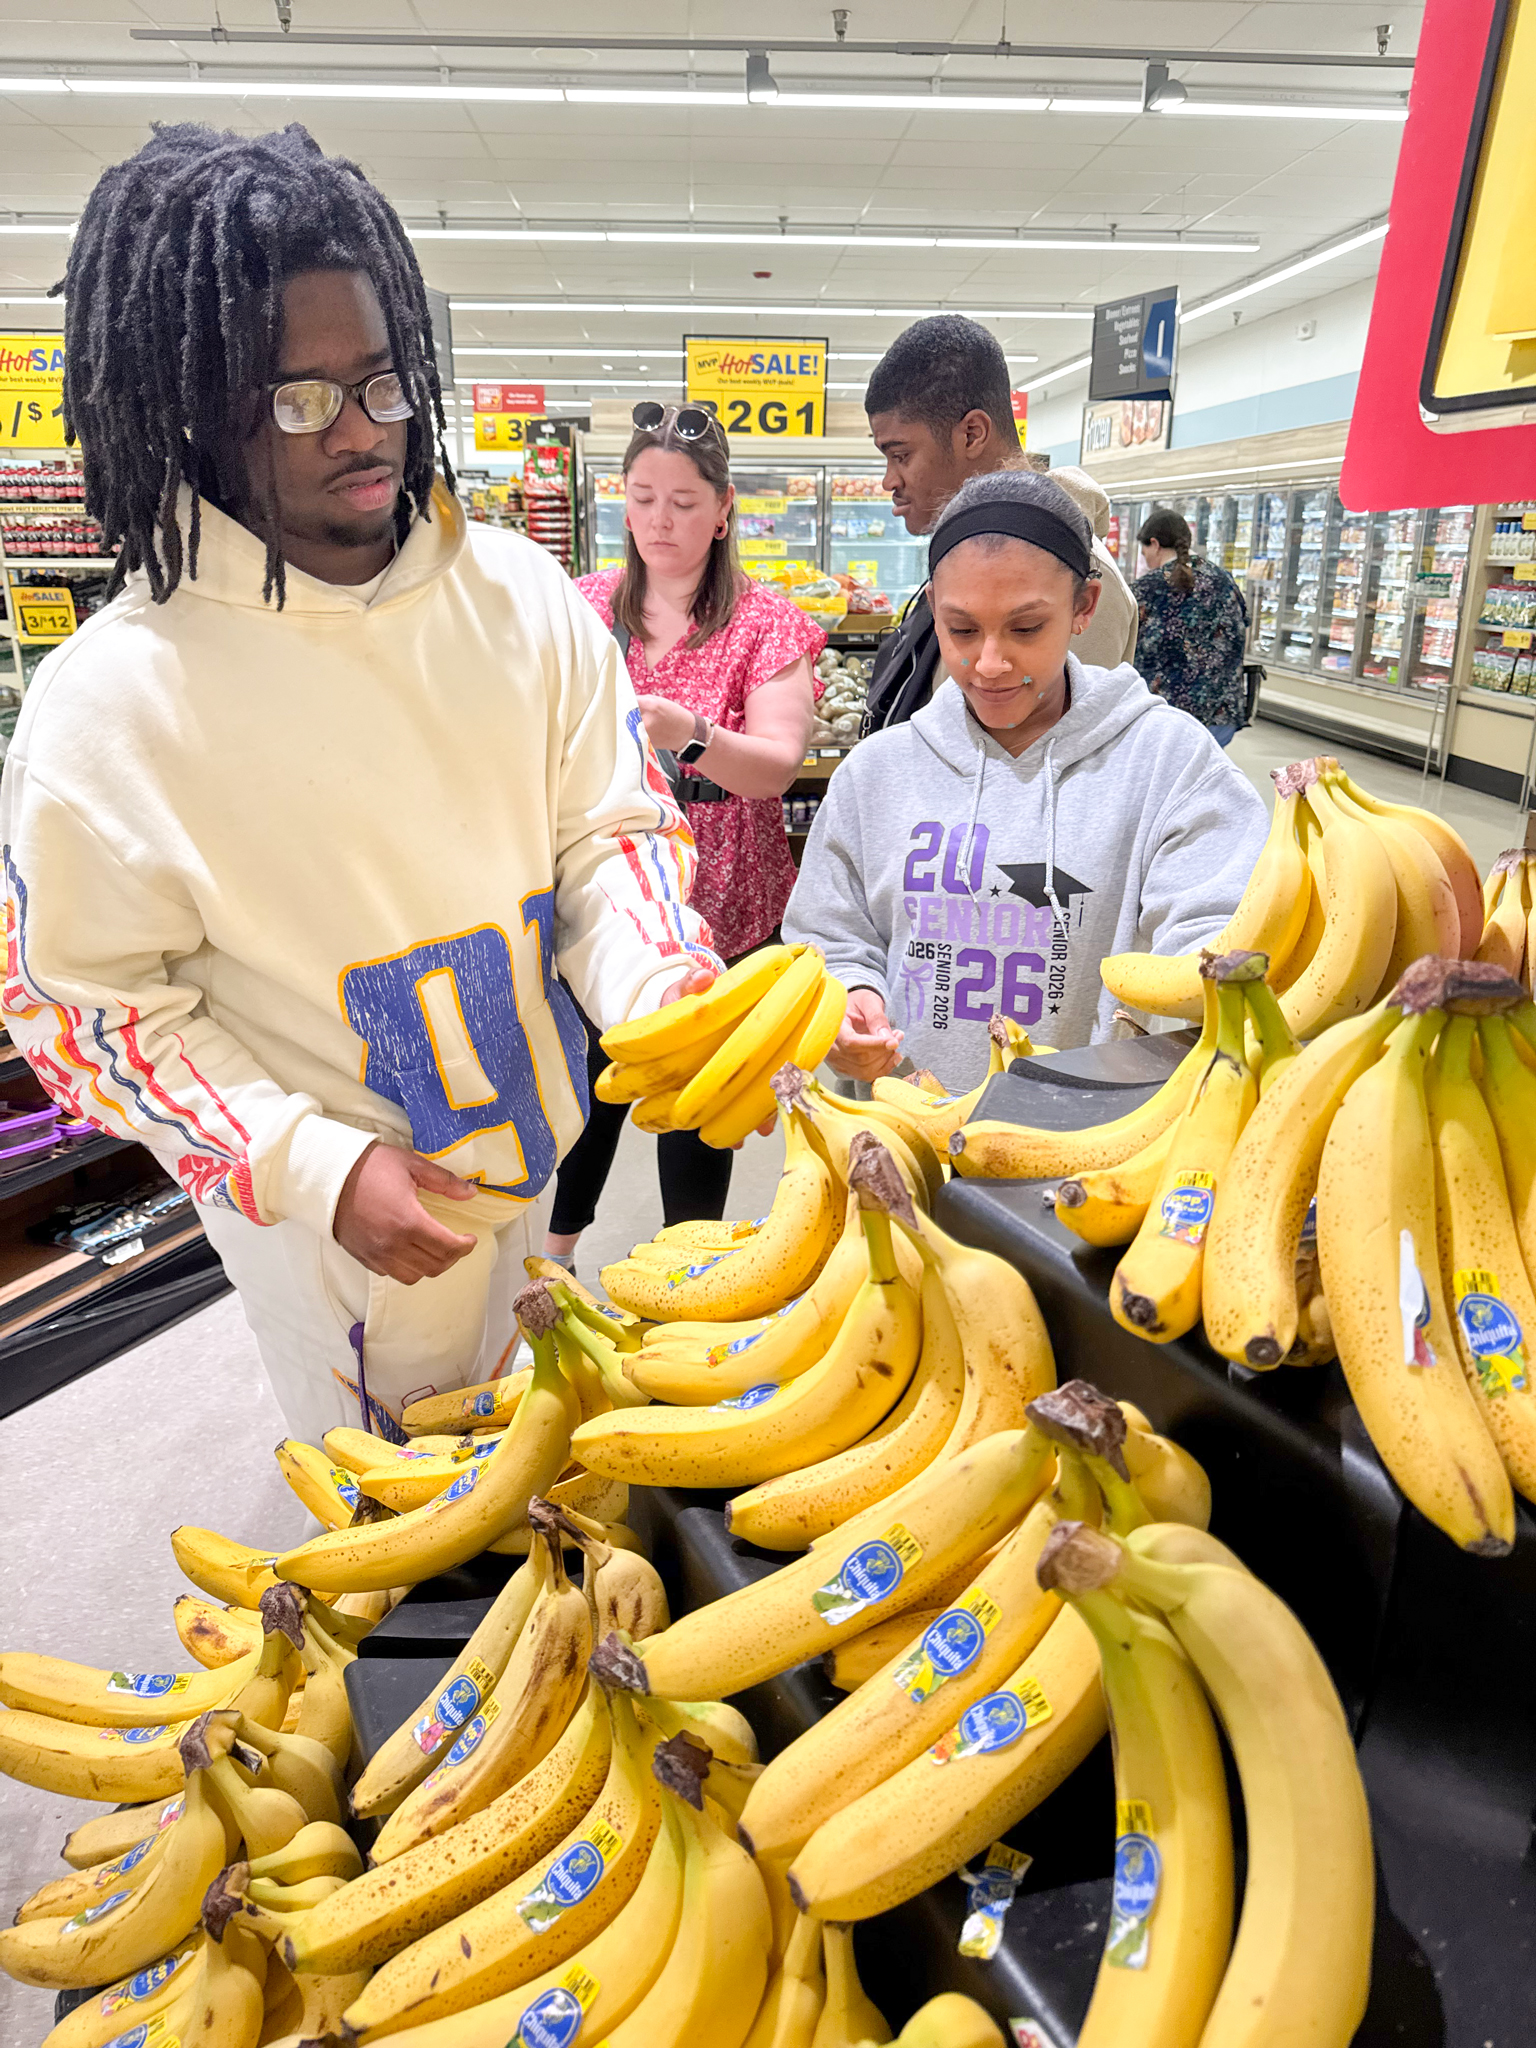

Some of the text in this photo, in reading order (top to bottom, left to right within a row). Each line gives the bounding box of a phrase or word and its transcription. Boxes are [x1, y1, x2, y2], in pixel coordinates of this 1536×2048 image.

[1157, 320, 1165, 358] 1
[697, 358, 718, 370] MVP
[903, 821, 991, 895] 20
[1047, 911, 1071, 999] SENIOR 2026
[932, 943, 952, 1030] SENIOR 2026
[953, 947, 1046, 1026] 26
[846, 1556, 881, 1600] Chiquita
[926, 1628, 964, 1670] Chiquita
[439, 1691, 465, 1727] Chiquita
[551, 1862, 583, 1901] Chiquita
